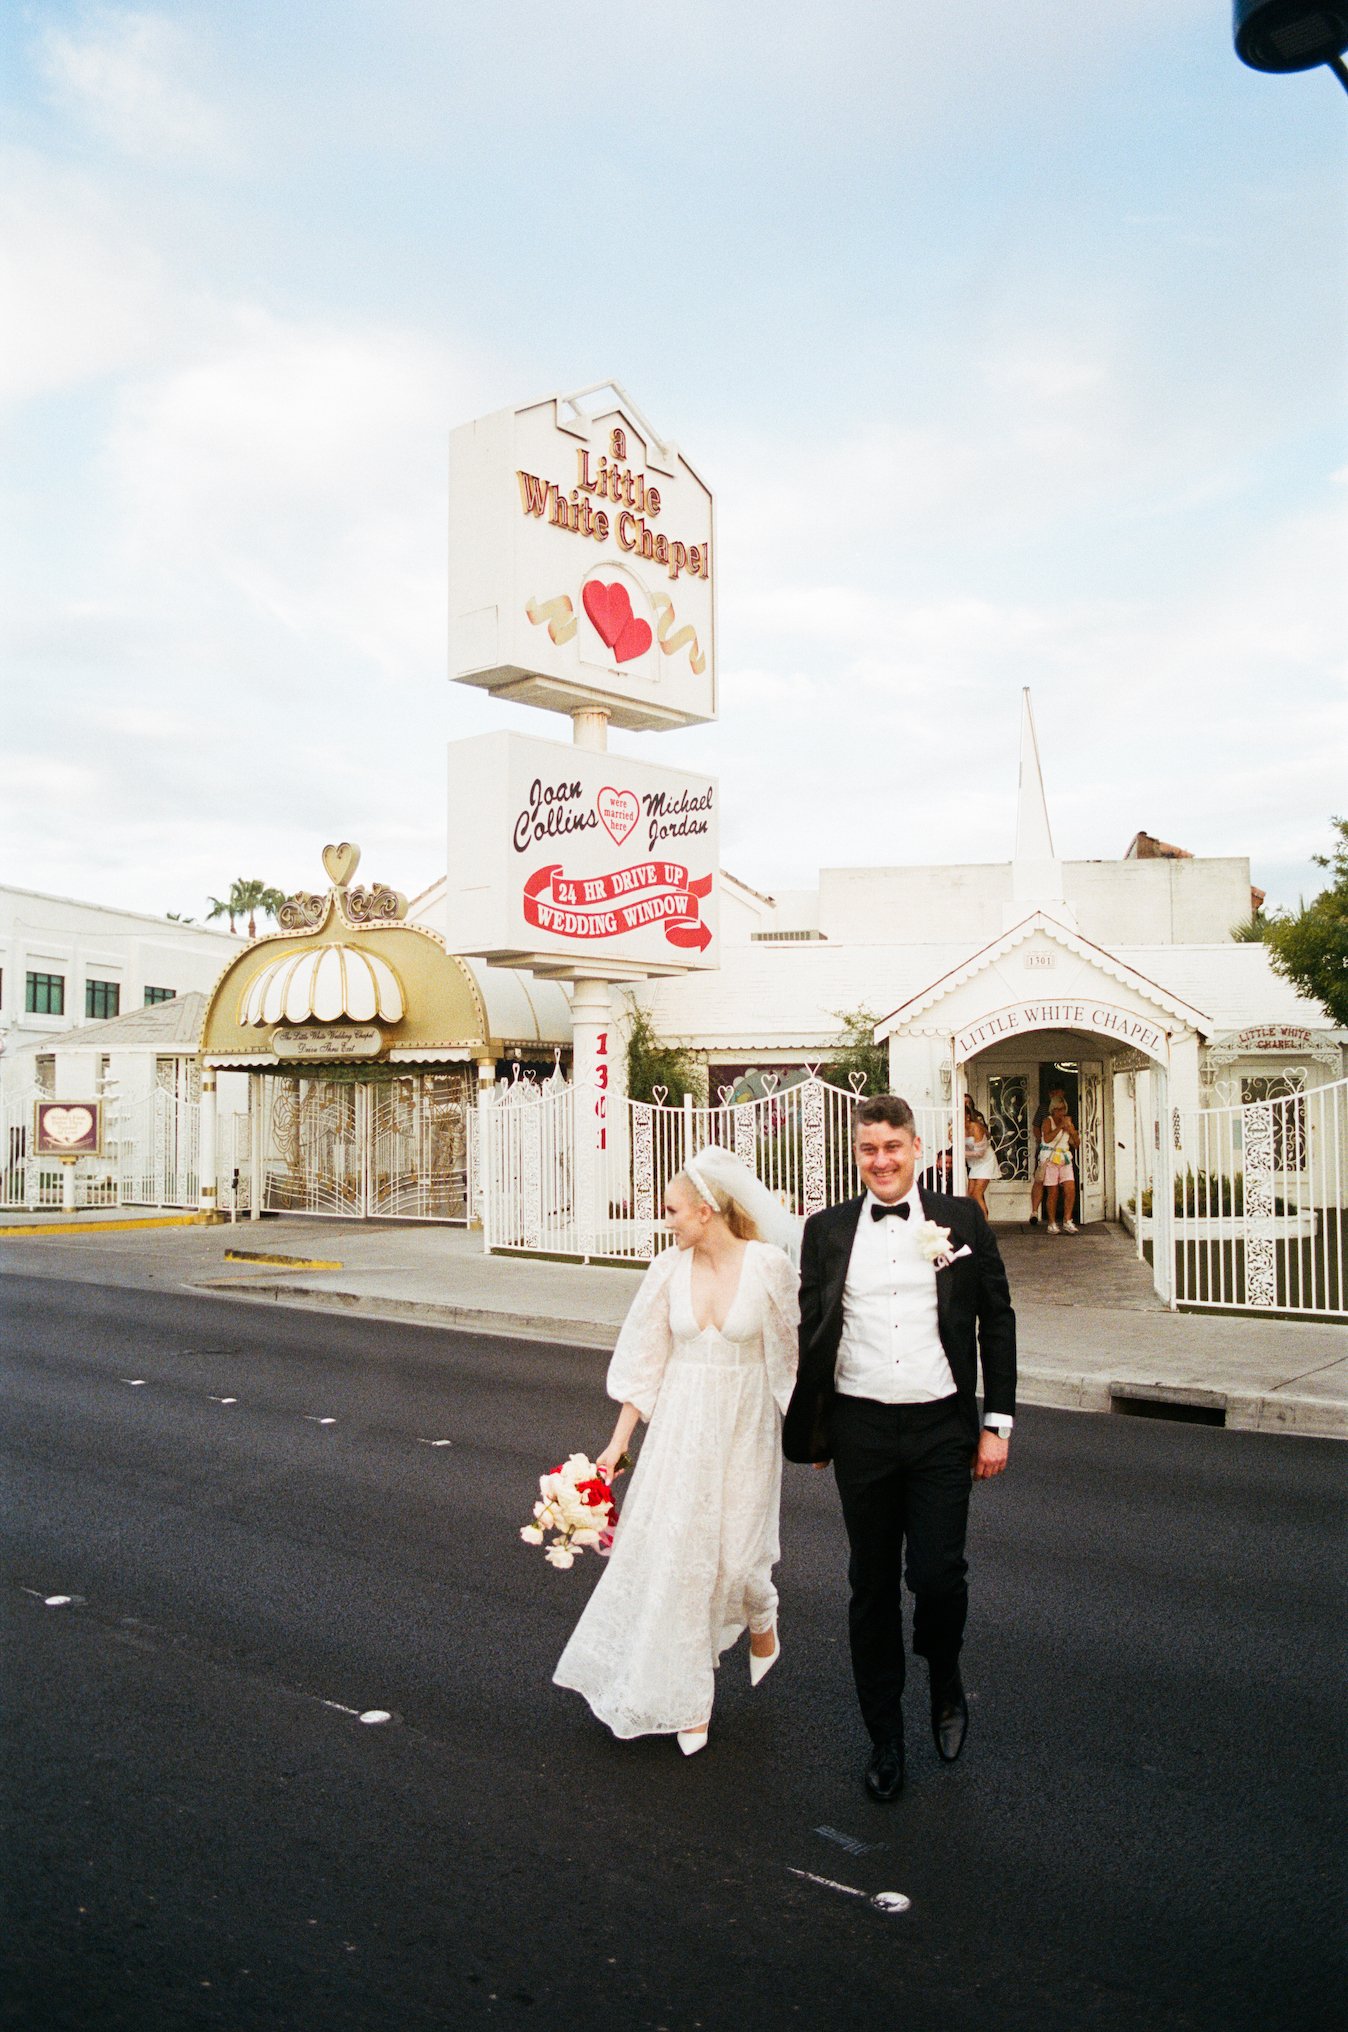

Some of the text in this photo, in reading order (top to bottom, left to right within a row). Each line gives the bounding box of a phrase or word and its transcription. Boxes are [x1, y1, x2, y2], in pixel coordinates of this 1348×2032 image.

[610, 427, 626, 461] a
[577, 448, 661, 517] Little
[516, 470, 709, 580] White Chapel
[530, 778, 583, 823] Joan
[604, 809, 634, 821] married
[610, 798, 627, 808] were
[642, 786, 713, 817] Michael
[513, 806, 599, 852] Collins
[610, 819, 627, 831] here
[649, 815, 708, 852] Jordan
[558, 865, 684, 904] 24 HR DRIVE UP
[537, 896, 689, 936] WEDDING WINDOW
[959, 1005, 1160, 1051] LITTLE WHITE CHAPEL
[1239, 1027, 1312, 1042] LITTLE WHITE
[1256, 1040, 1297, 1049] CHAPEL
